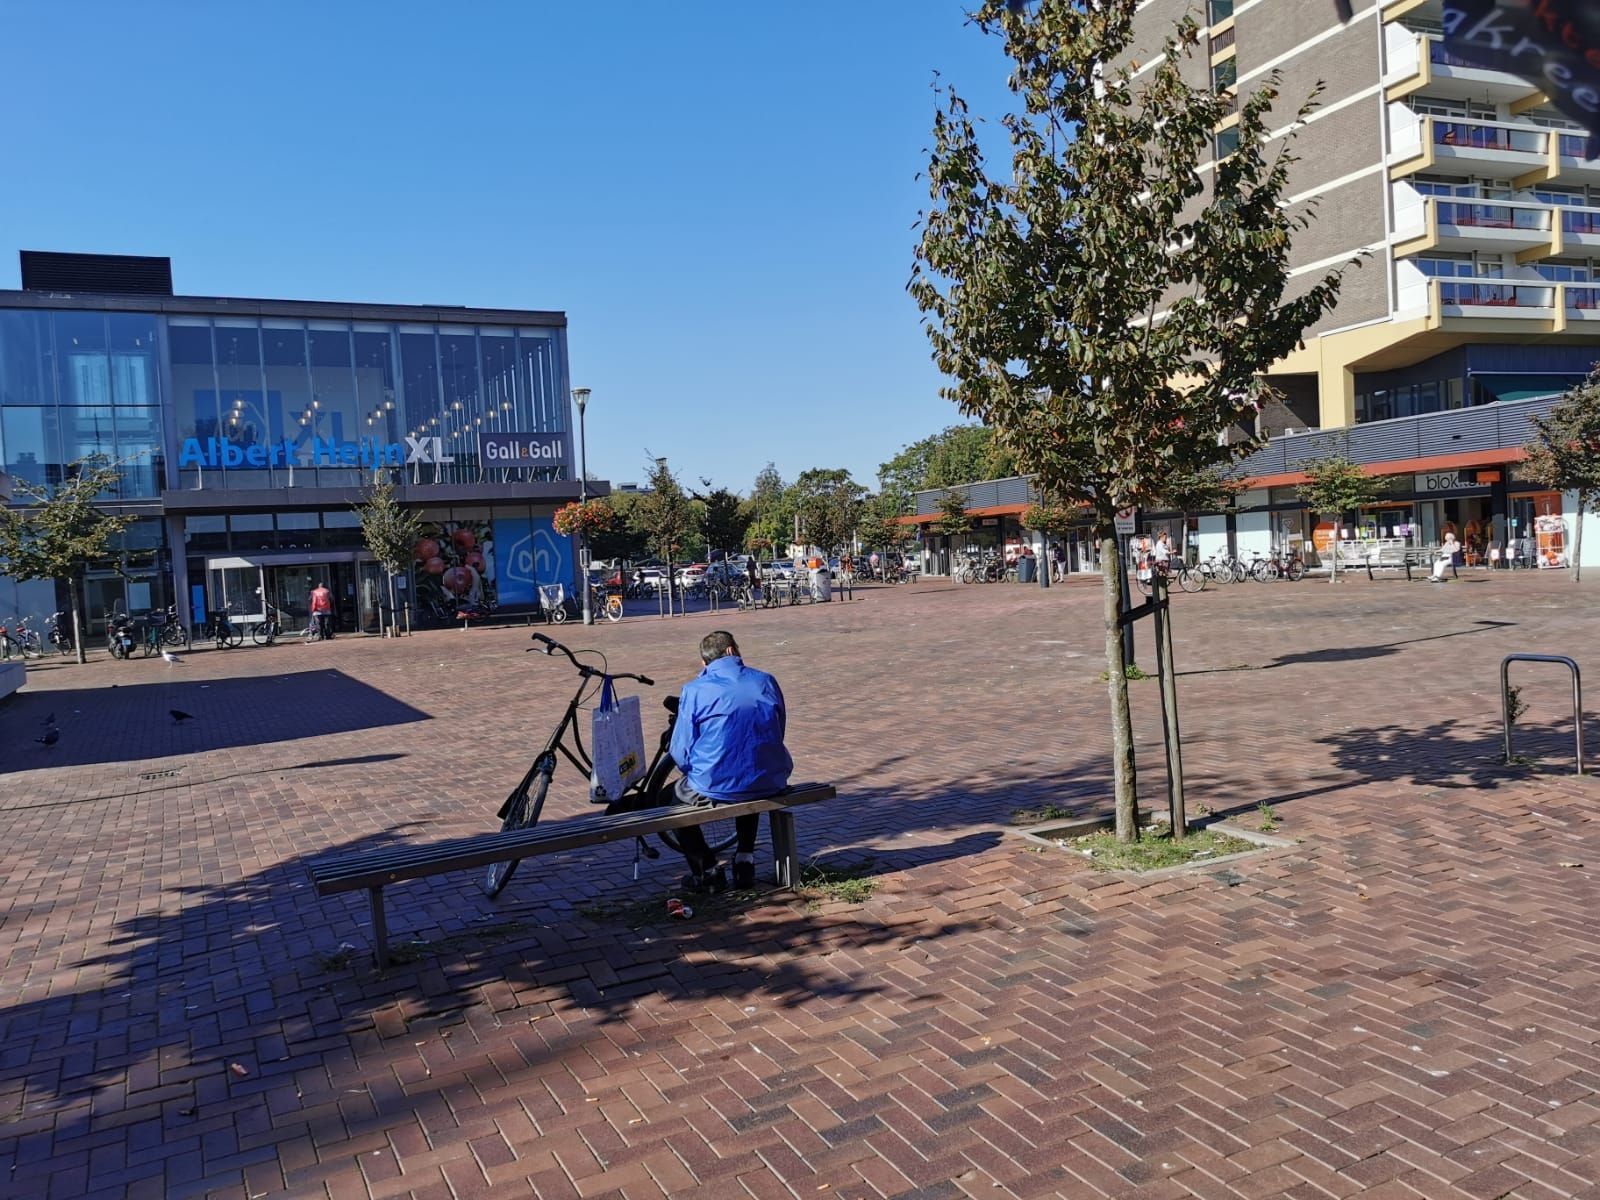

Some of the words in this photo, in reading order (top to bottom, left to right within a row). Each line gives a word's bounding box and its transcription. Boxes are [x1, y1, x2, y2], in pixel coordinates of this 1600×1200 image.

[179, 436, 301, 467] Albert
[311, 434, 405, 471] Heijn
[404, 436, 455, 464] XL
